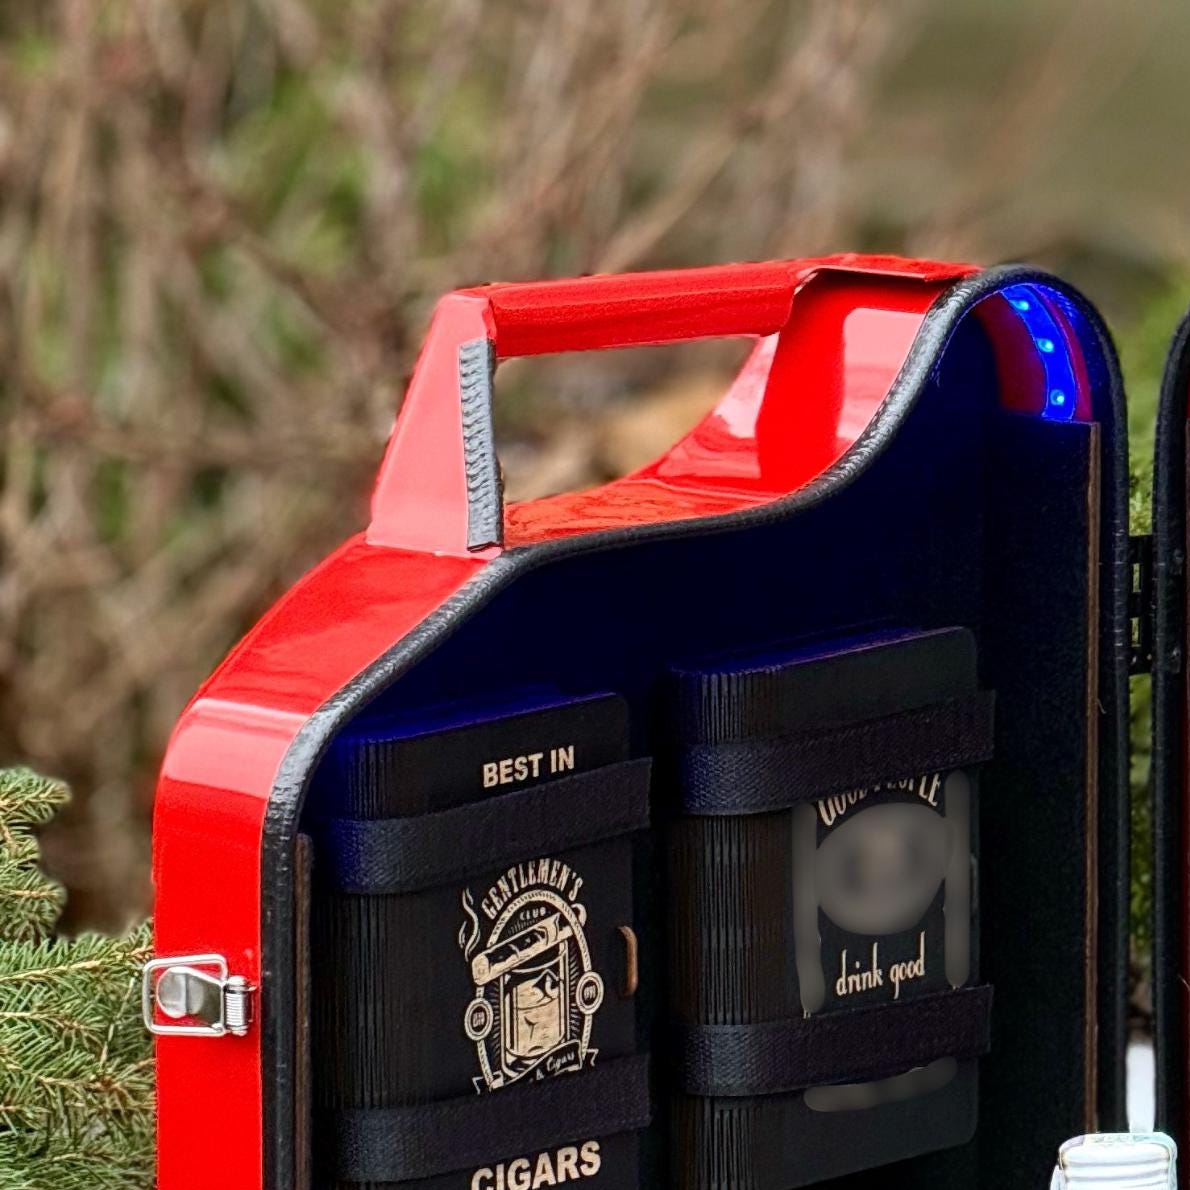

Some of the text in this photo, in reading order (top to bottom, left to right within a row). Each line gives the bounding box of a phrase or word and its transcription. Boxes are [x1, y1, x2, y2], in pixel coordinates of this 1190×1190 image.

[483, 745, 575, 788] BEST IN
[481, 857, 584, 920] GENTLEMEN'S
[520, 906, 546, 920] CLUB
[836, 930, 926, 1000] drink good
